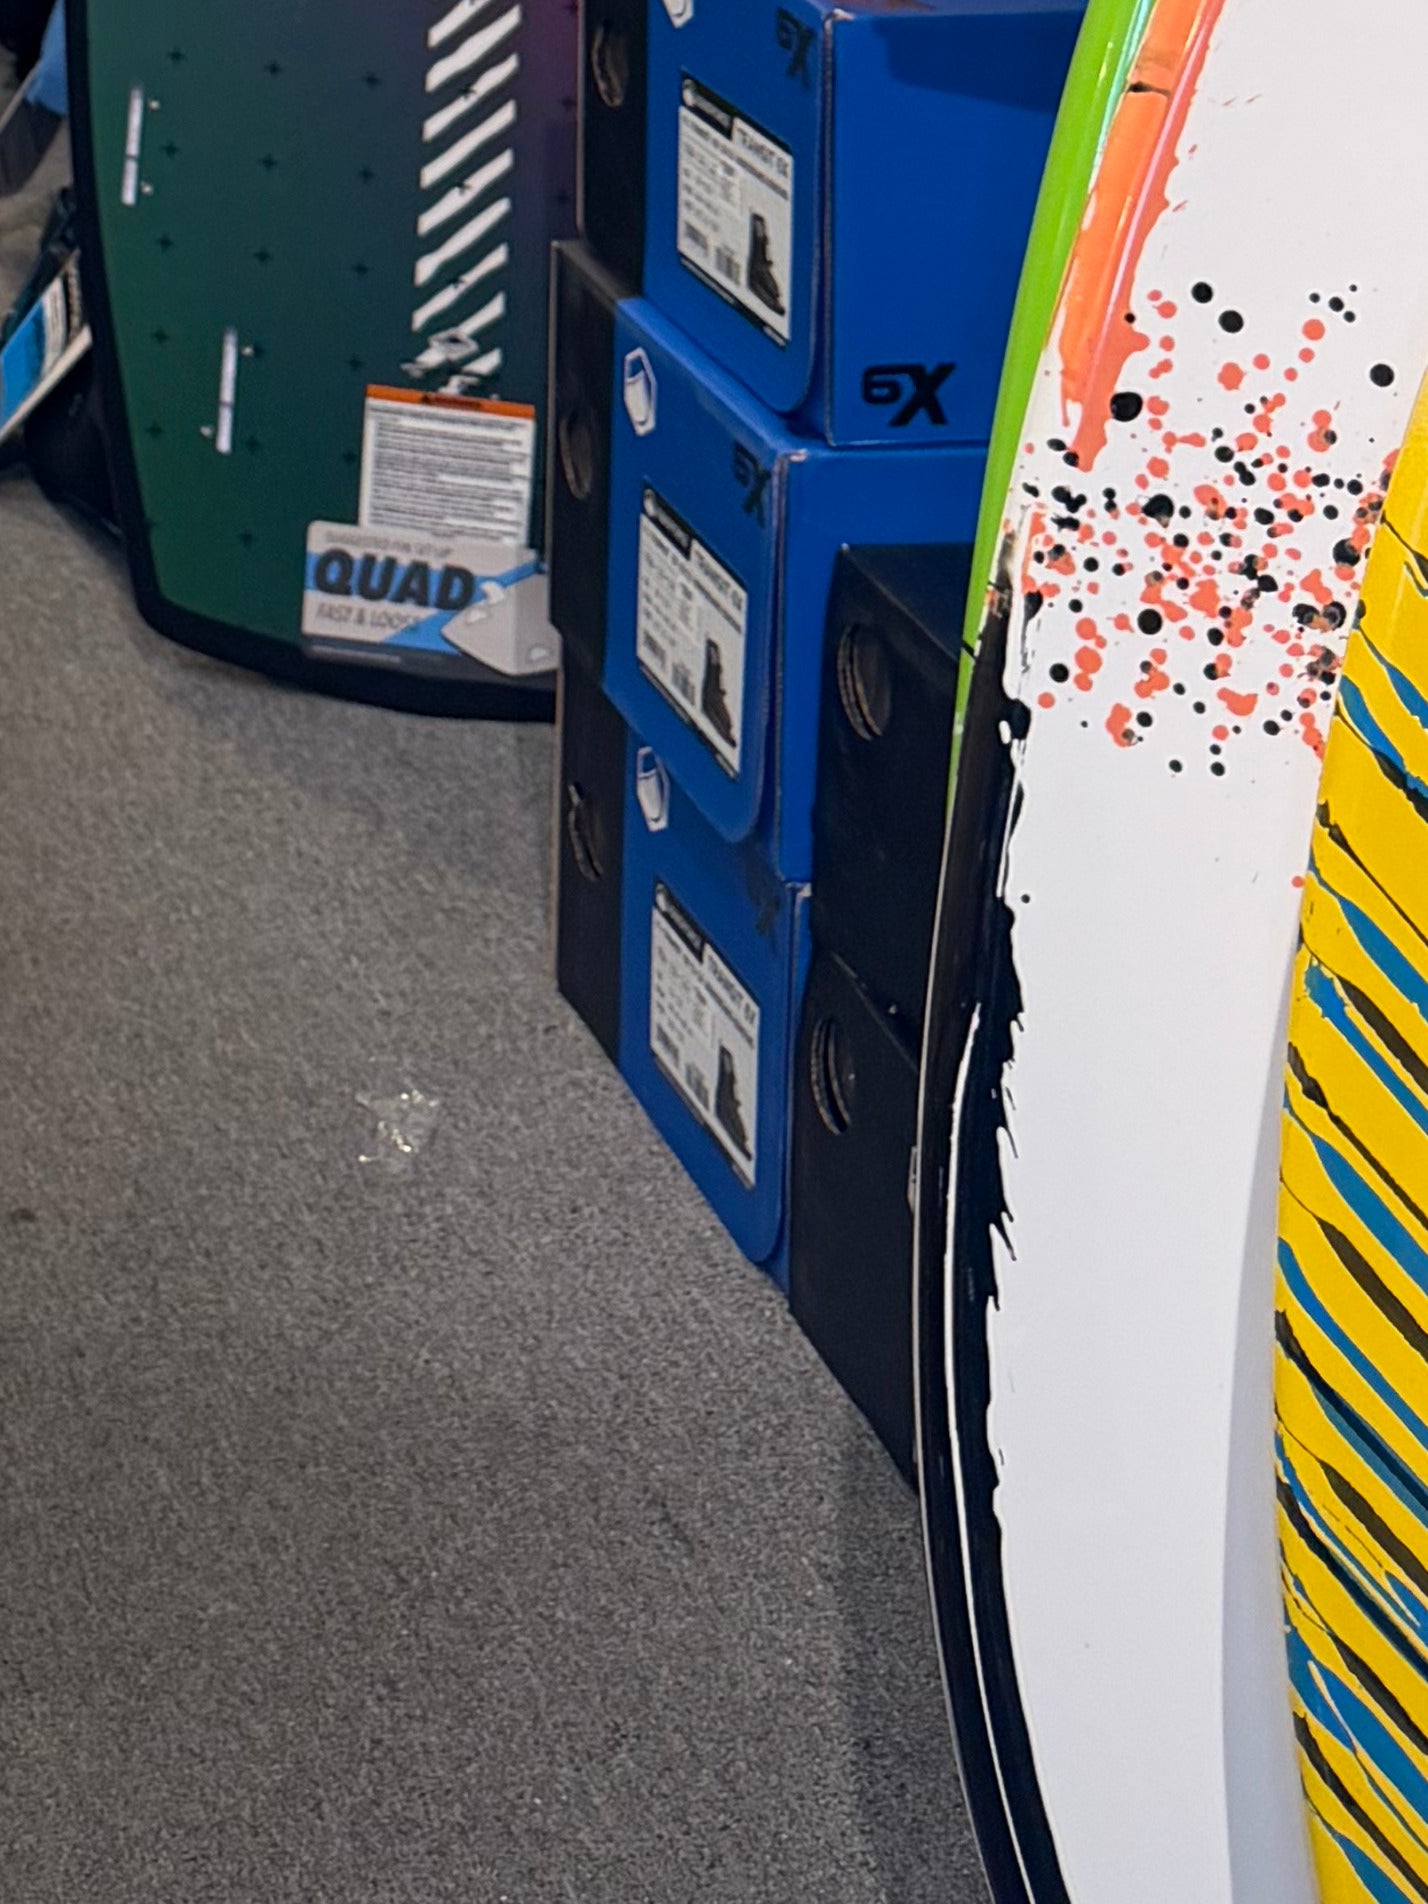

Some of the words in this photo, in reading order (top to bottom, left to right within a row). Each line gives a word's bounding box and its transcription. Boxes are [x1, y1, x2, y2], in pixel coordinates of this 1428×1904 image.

[861, 362, 958, 428] 6X
[314, 549, 475, 611] QUAD
[316, 600, 353, 623] FAST
